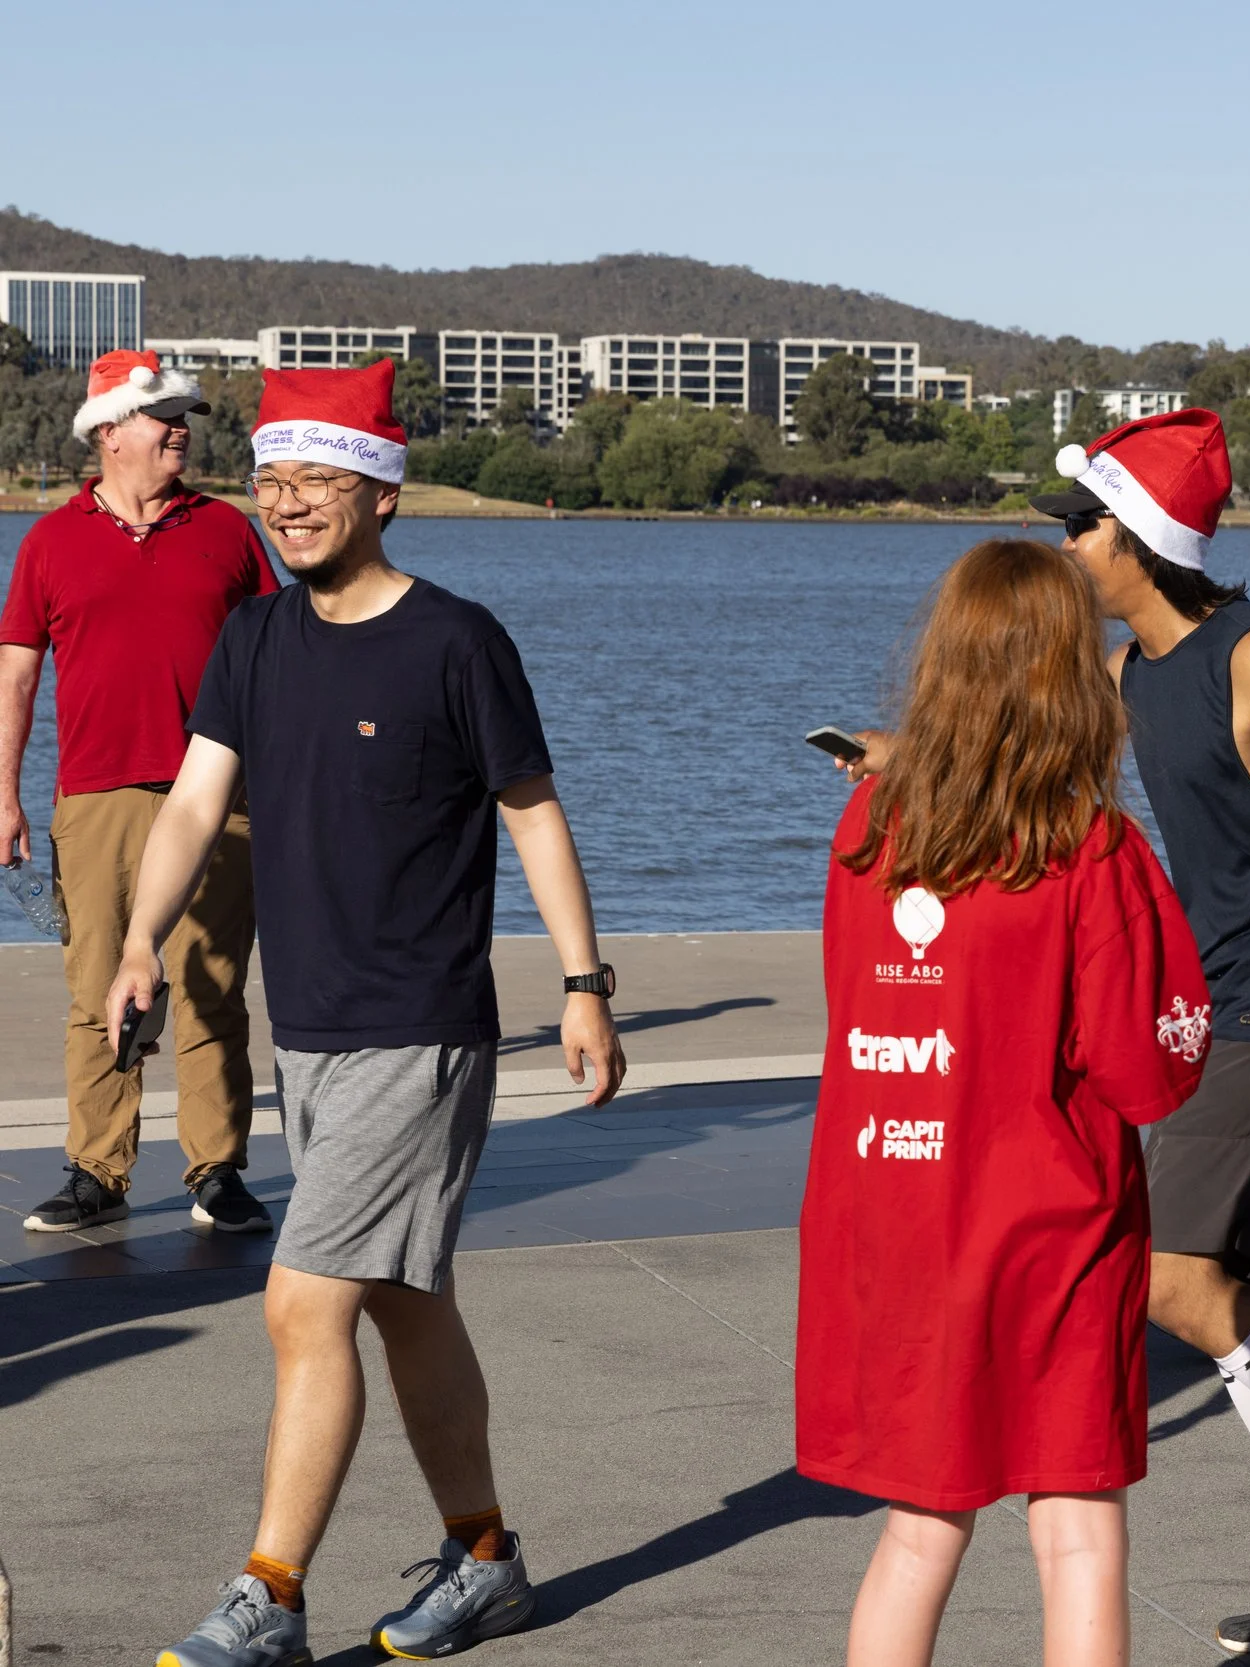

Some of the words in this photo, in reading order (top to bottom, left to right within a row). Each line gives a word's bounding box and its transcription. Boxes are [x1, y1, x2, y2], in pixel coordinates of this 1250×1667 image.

[260, 428, 294, 440] ANYTIME
[297, 427, 350, 452] Santa
[350, 437, 381, 461] Run
[1102, 468, 1123, 494] Run
[875, 963, 904, 978] RISE
